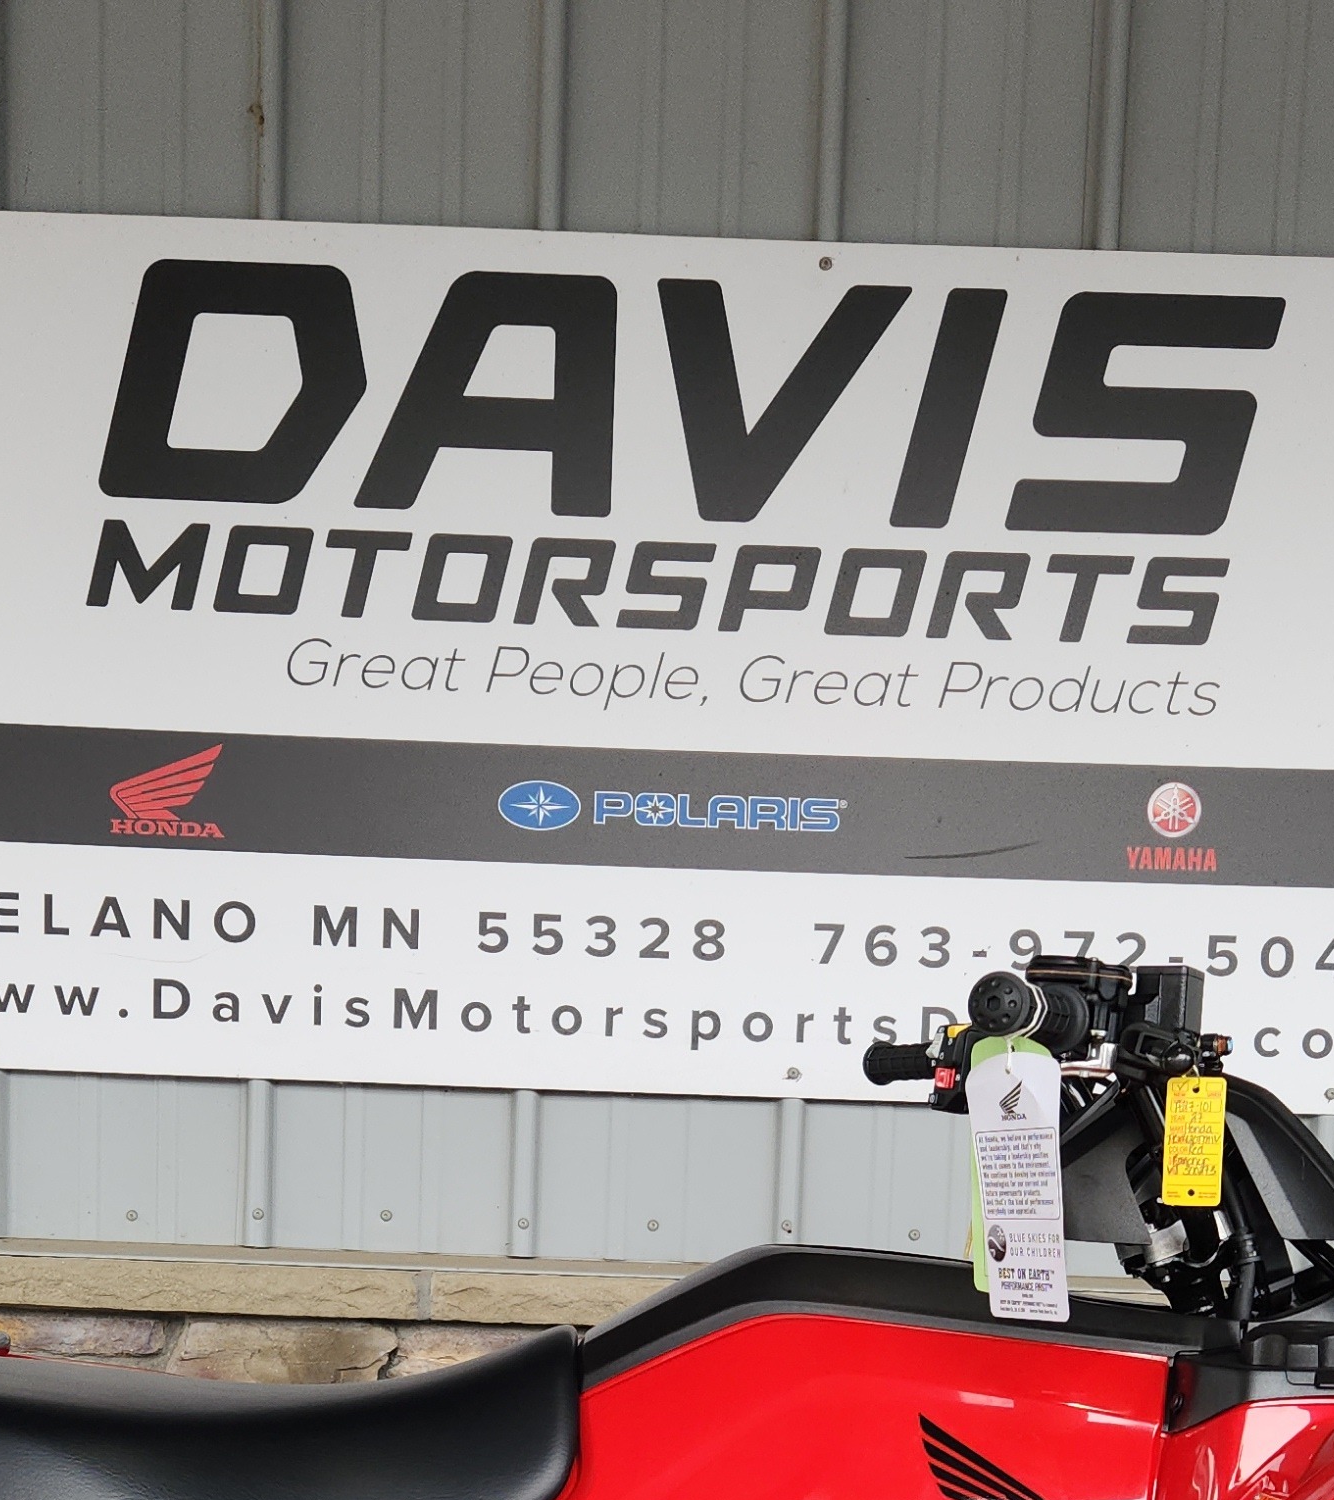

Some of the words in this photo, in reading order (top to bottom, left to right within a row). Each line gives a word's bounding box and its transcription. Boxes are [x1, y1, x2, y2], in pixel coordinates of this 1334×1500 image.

[97, 257, 1288, 537] DAVIS
[85, 518, 1232, 647] MOTORSPORTS
[286, 636, 466, 692] Great
[485, 645, 709, 711] People,
[739, 654, 919, 708] Great
[937, 661, 1222, 717] Products
[593, 790, 841, 832] POLARIS
[110, 818, 225, 839] HONDA
[1126, 846, 1217, 872] YAMAHA
[311, 903, 421, 951] MN
[476, 910, 726, 963] 55328
[1001, 1113, 1027, 1121] HONDA
[1009, 1233, 1025, 1242] BLUE
[1028, 1233, 1046, 1243] SKIES
[1048, 1234, 1060, 1243] FOR
[1010, 1247, 1024, 1256] OUR
[1027, 1247, 1061, 1258] CHILDREN
[998, 1268, 1015, 1278] BEST
[1017, 1268, 1026, 1279] ON
[1001, 1281, 1034, 1291] PERFORMANCE
